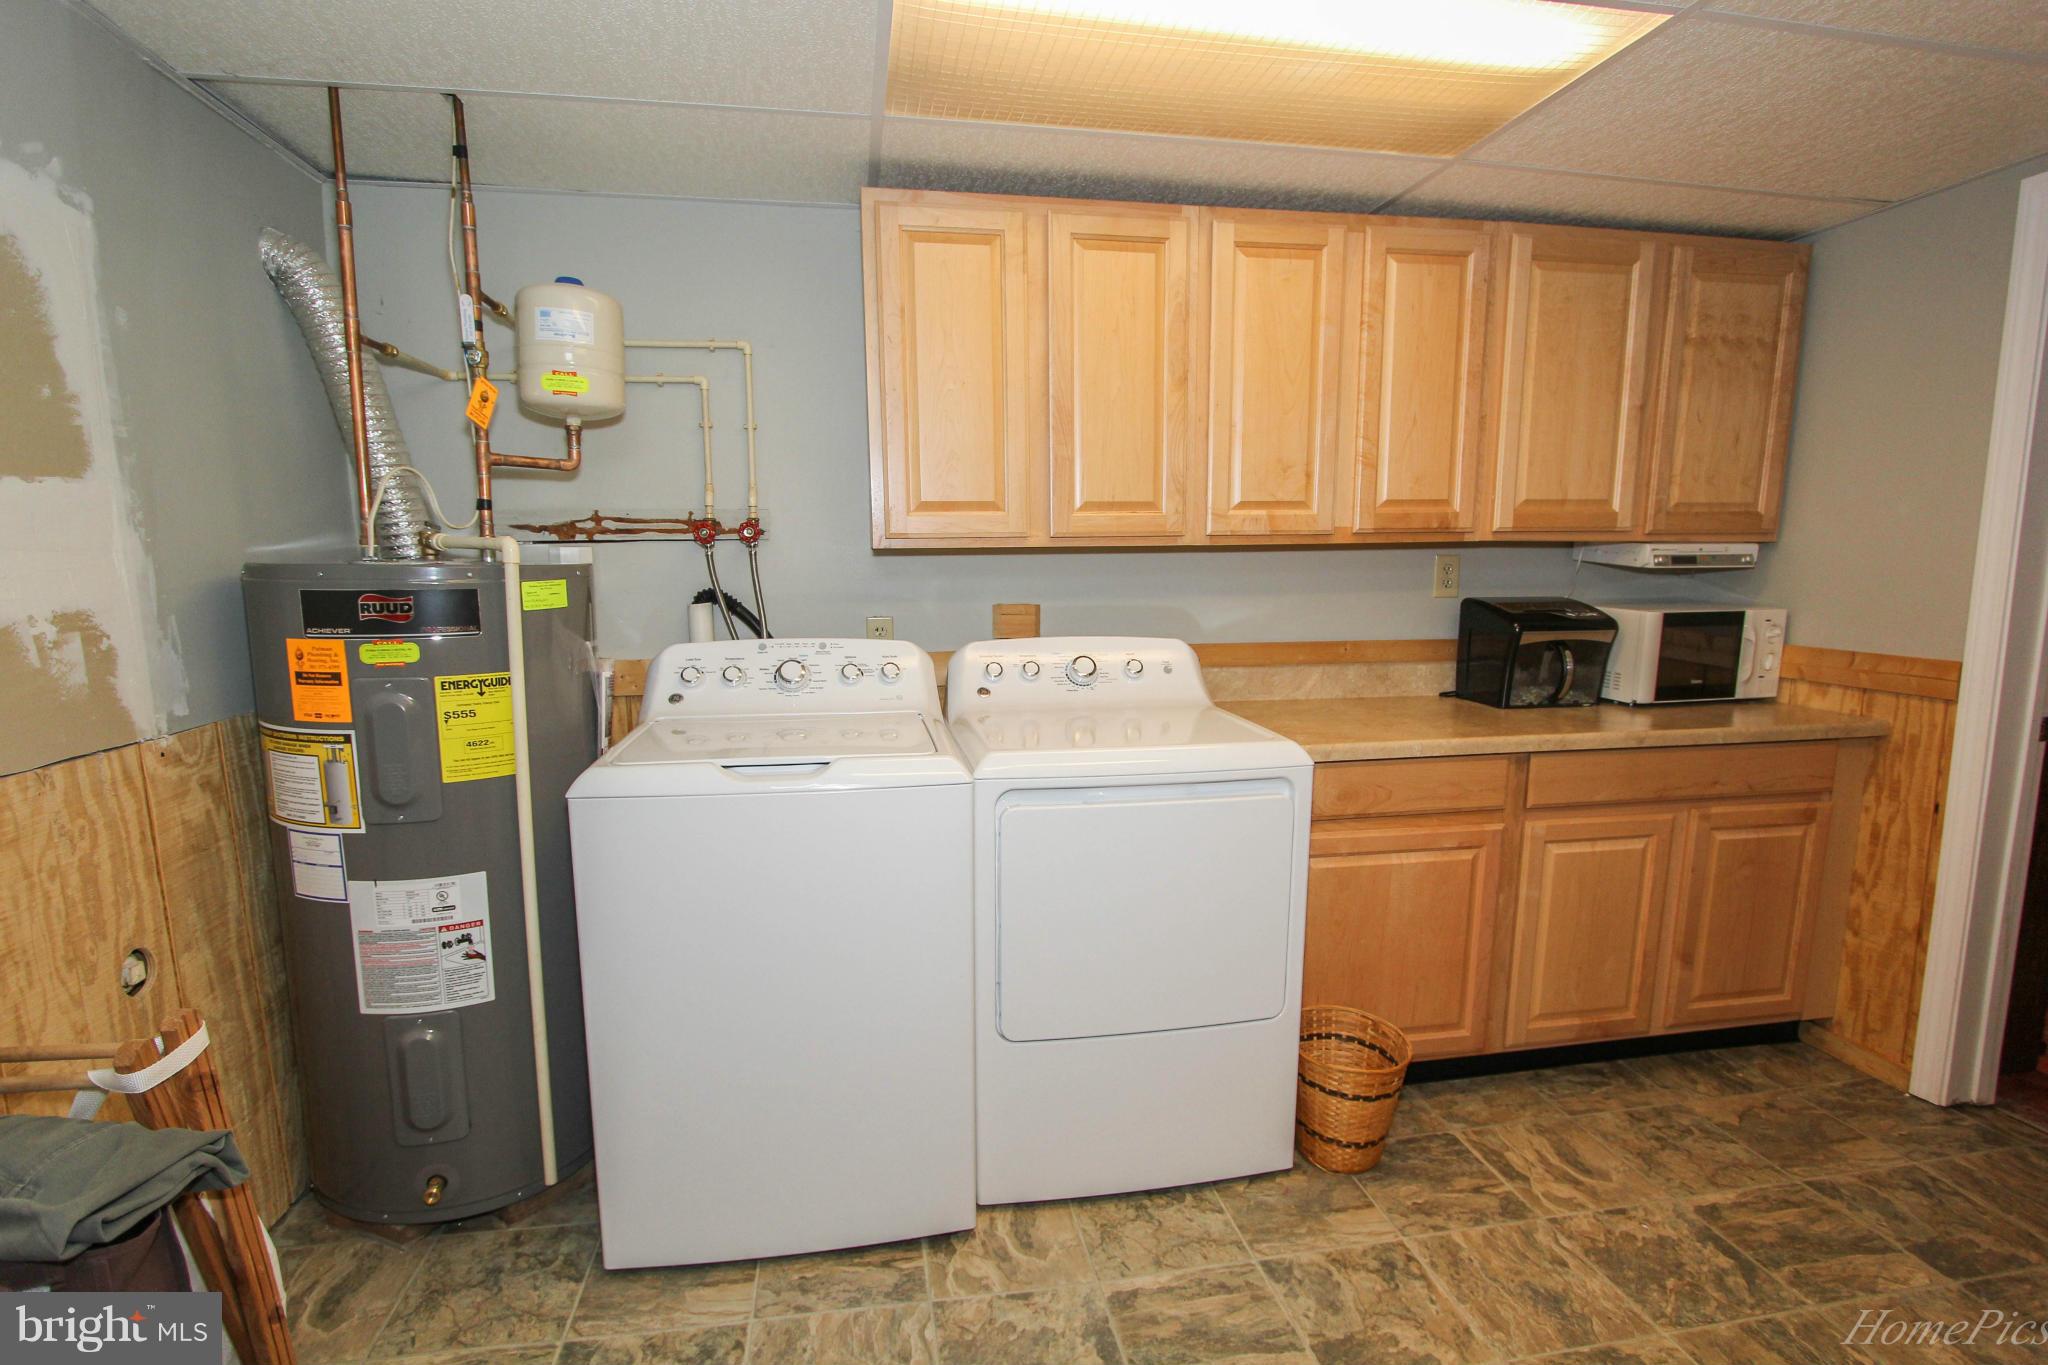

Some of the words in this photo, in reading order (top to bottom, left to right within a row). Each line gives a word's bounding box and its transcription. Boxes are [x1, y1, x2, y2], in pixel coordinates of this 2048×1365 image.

[360, 602, 414, 614] RUUD
[443, 709, 477, 720] $555
[465, 739, 490, 747] 4622
[449, 921, 481, 930] DANGER
